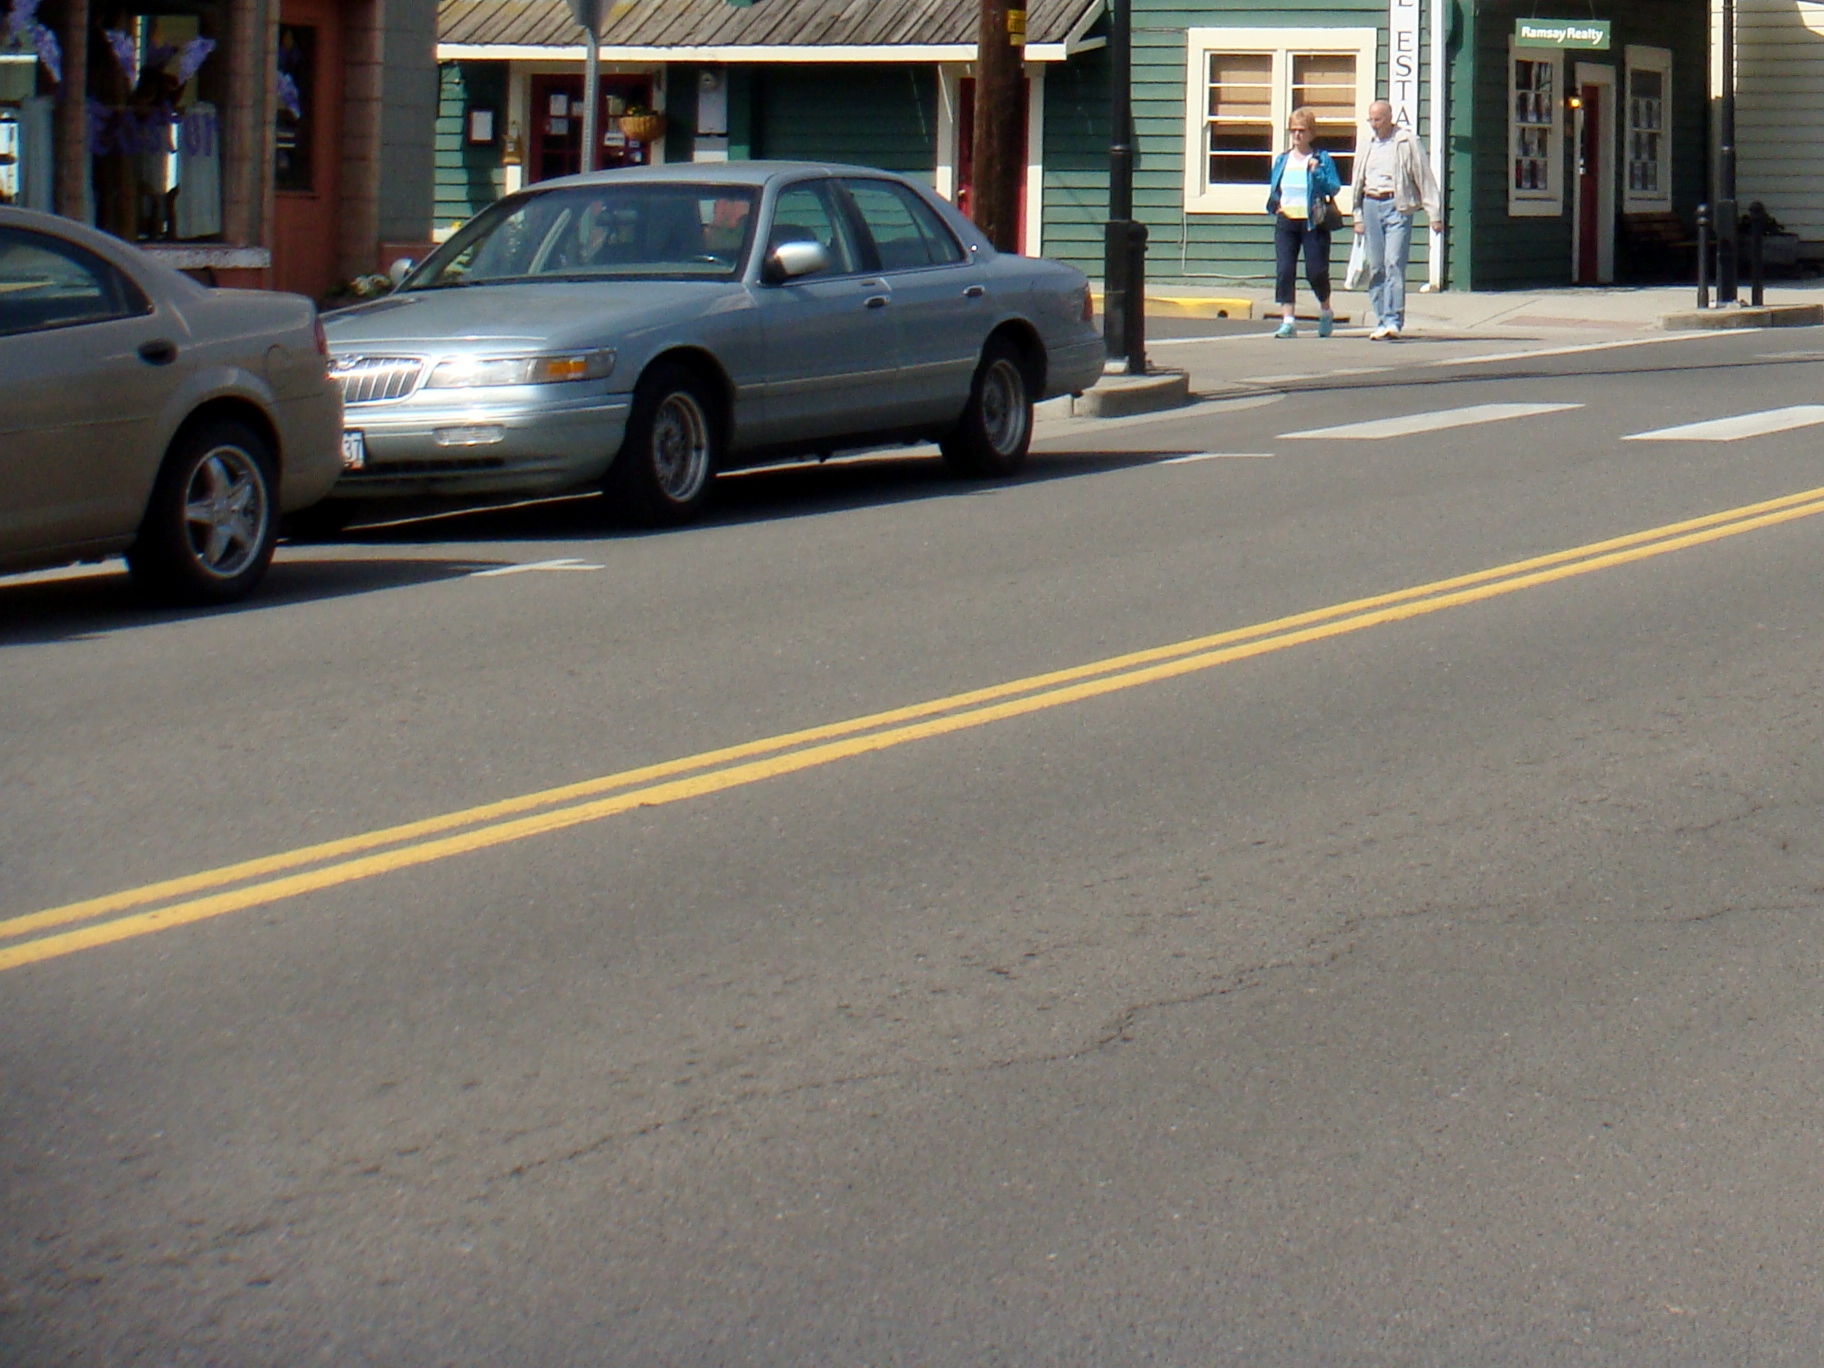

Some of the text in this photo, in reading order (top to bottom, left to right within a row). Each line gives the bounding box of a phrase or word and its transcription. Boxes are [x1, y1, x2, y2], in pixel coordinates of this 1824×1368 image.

[1521, 25, 1604, 45] Ramsay Realty
[1395, 31, 1413, 132] ESTA
